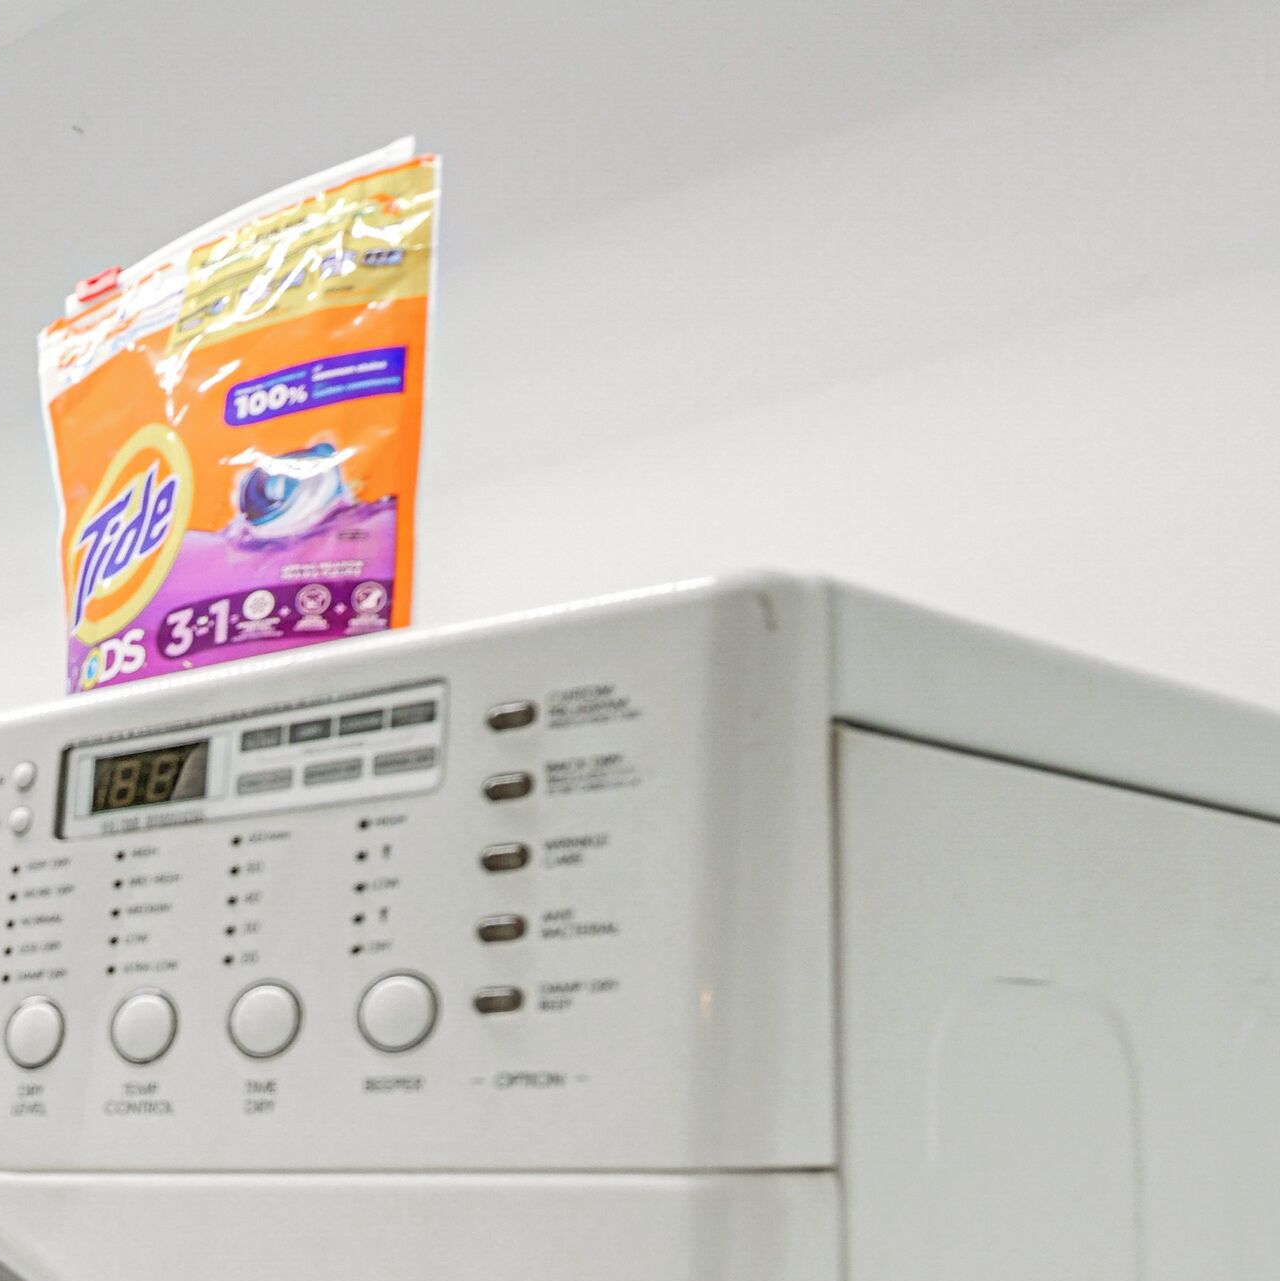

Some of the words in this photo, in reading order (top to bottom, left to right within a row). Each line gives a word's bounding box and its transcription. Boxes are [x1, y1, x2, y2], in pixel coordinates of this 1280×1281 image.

[233, 382, 309, 420] 100%
[73, 460, 179, 634] Tide
[76, 628, 147, 690] ODS
[493, 1070, 566, 1089] OPTION
